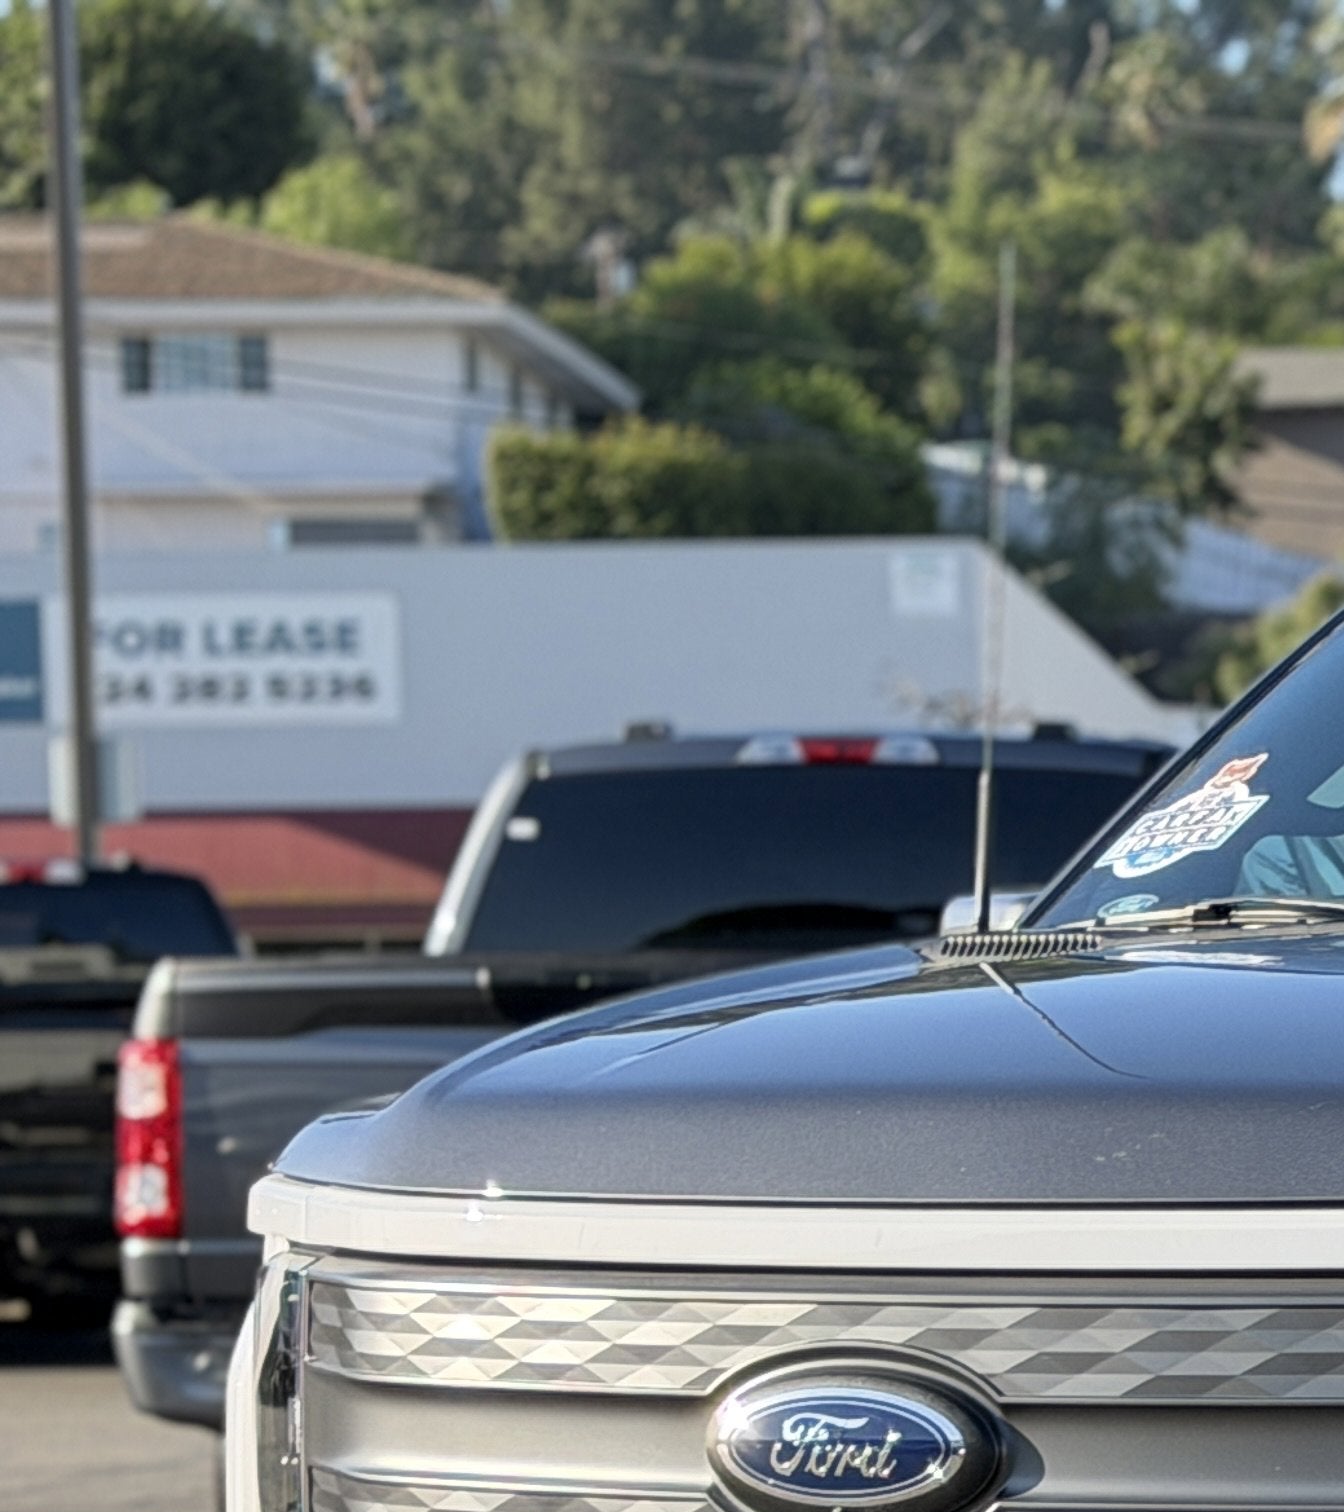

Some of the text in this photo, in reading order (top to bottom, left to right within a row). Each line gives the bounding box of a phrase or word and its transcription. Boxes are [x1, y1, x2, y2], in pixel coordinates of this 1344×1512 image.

[202, 618, 359, 657] LEASE
[1136, 808, 1247, 836] CARFAX
[769, 1411, 902, 1478] Ford
